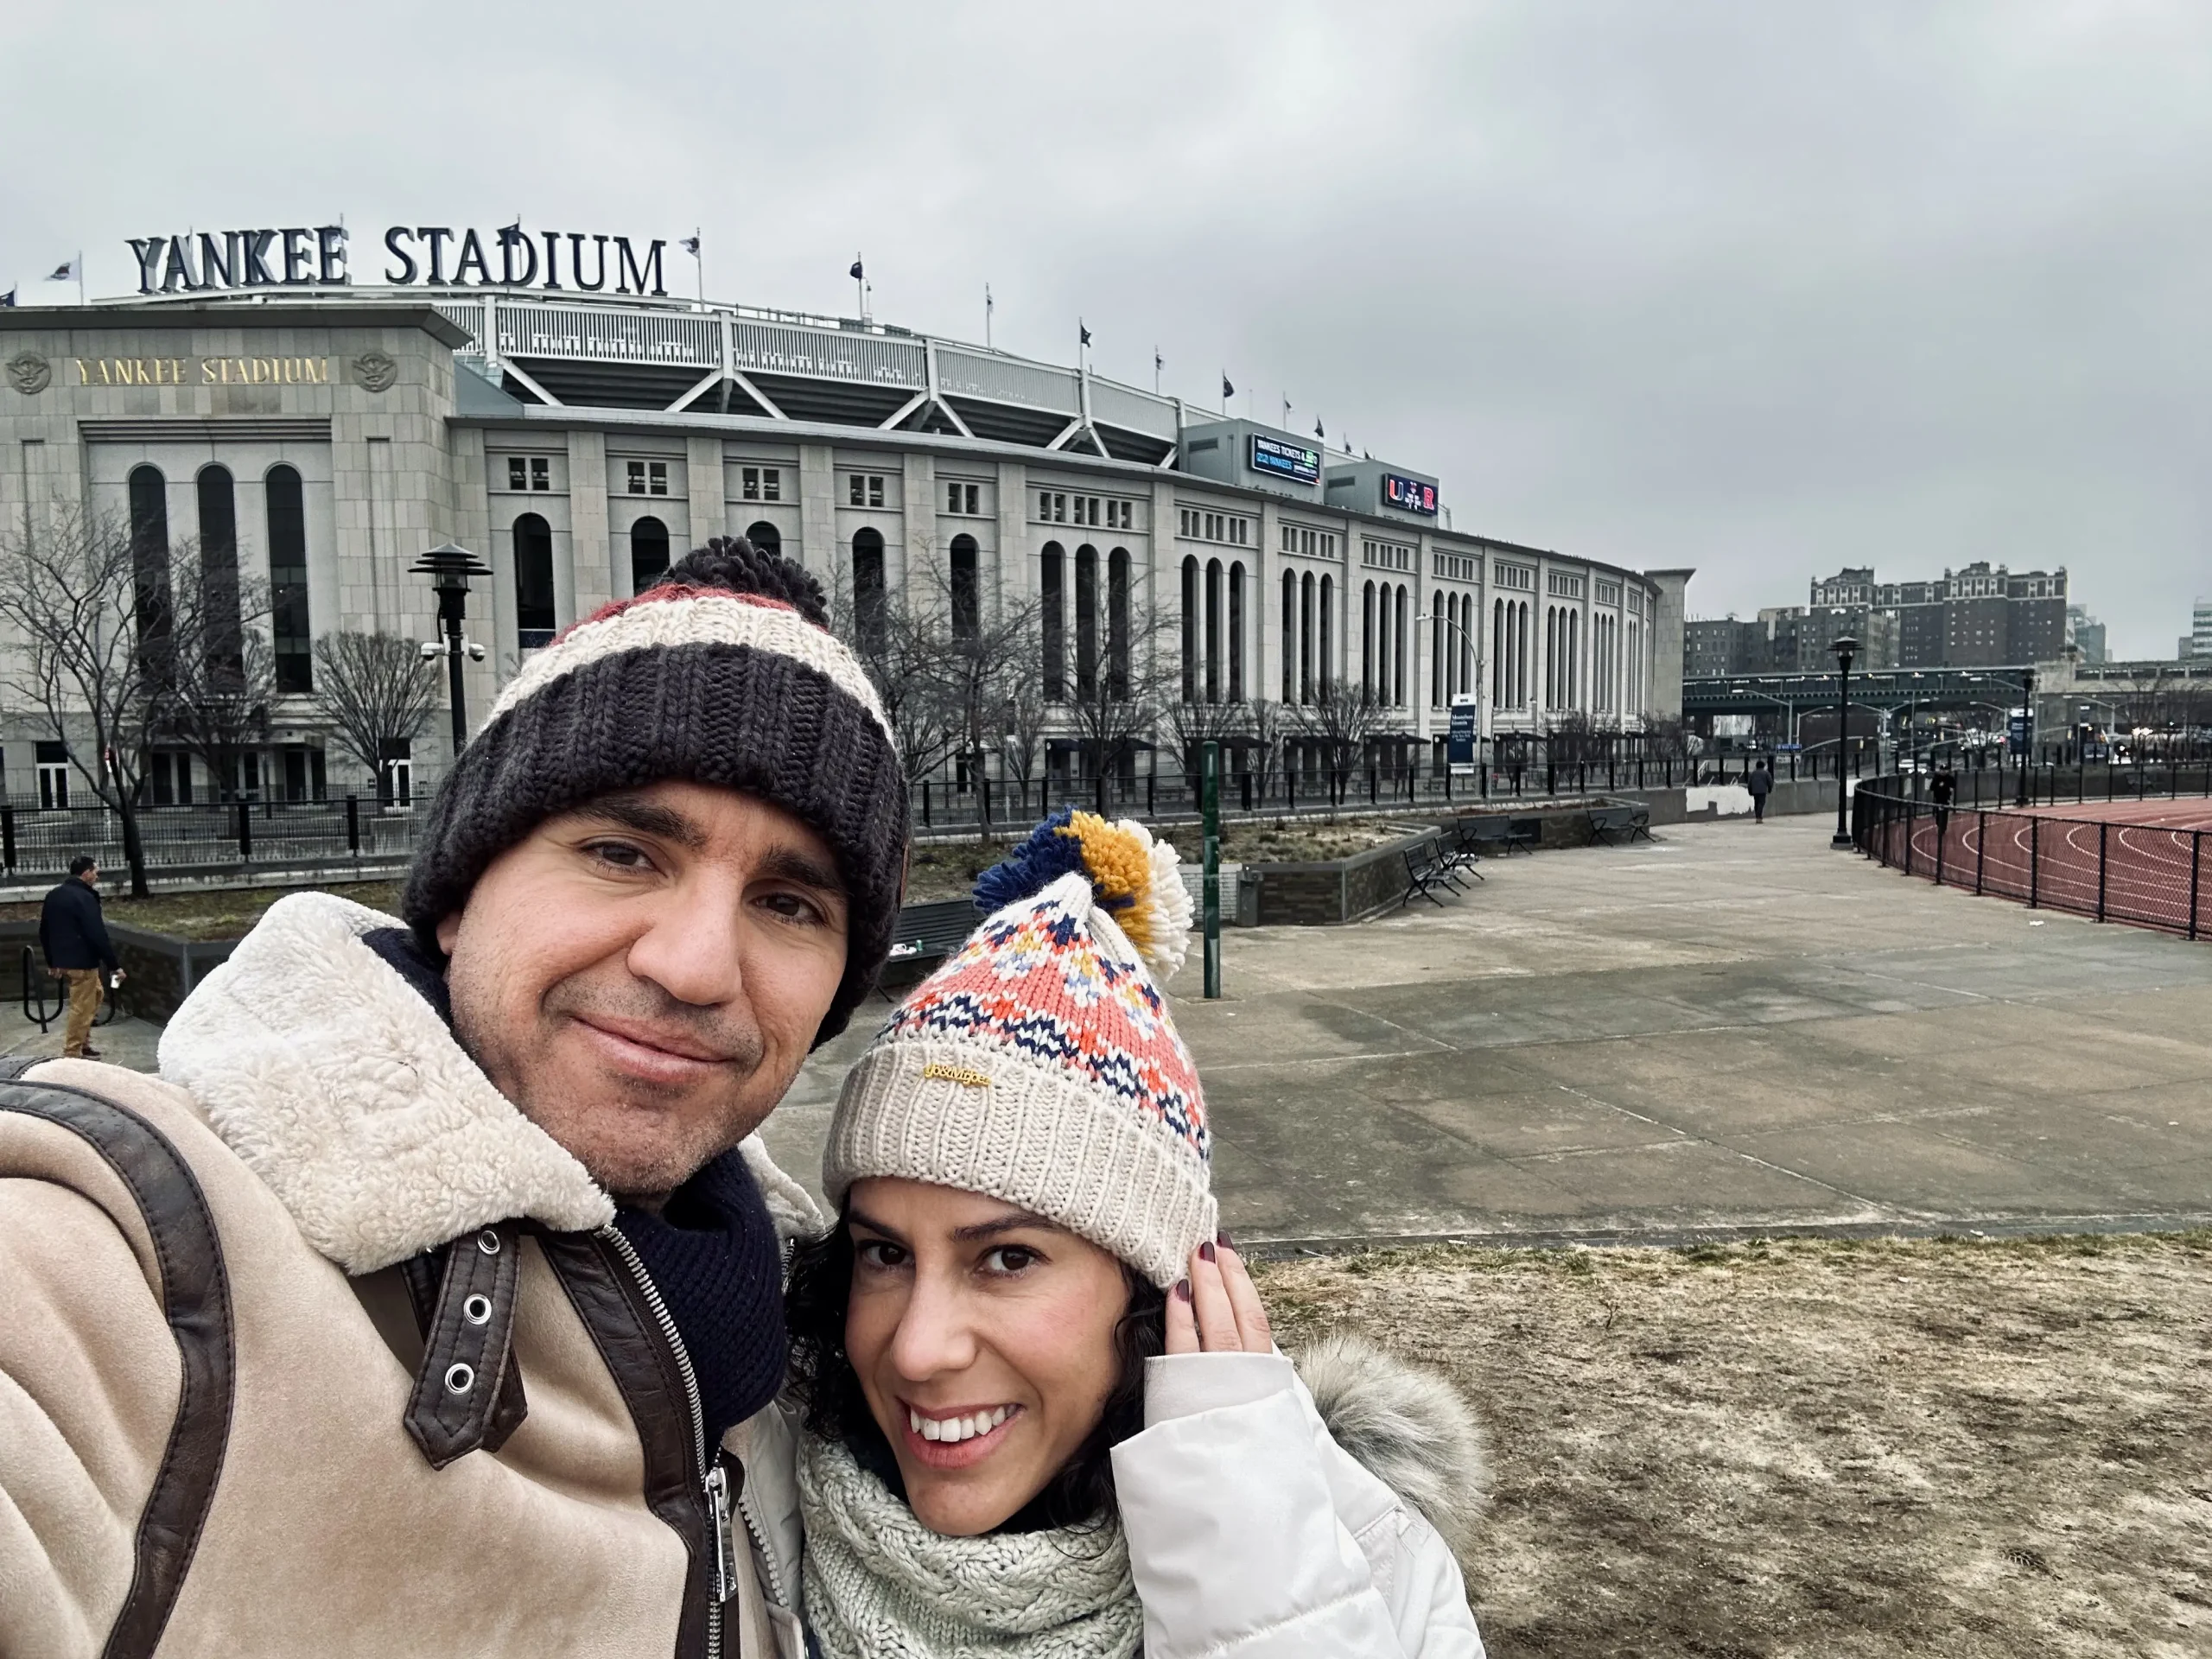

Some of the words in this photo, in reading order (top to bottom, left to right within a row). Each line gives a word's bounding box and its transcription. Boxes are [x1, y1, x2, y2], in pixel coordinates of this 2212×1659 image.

[125, 225, 350, 295] YANKEE
[384, 225, 668, 296] STADIUM
[75, 357, 188, 386] YANKEE
[200, 356, 330, 385] STADIUM
